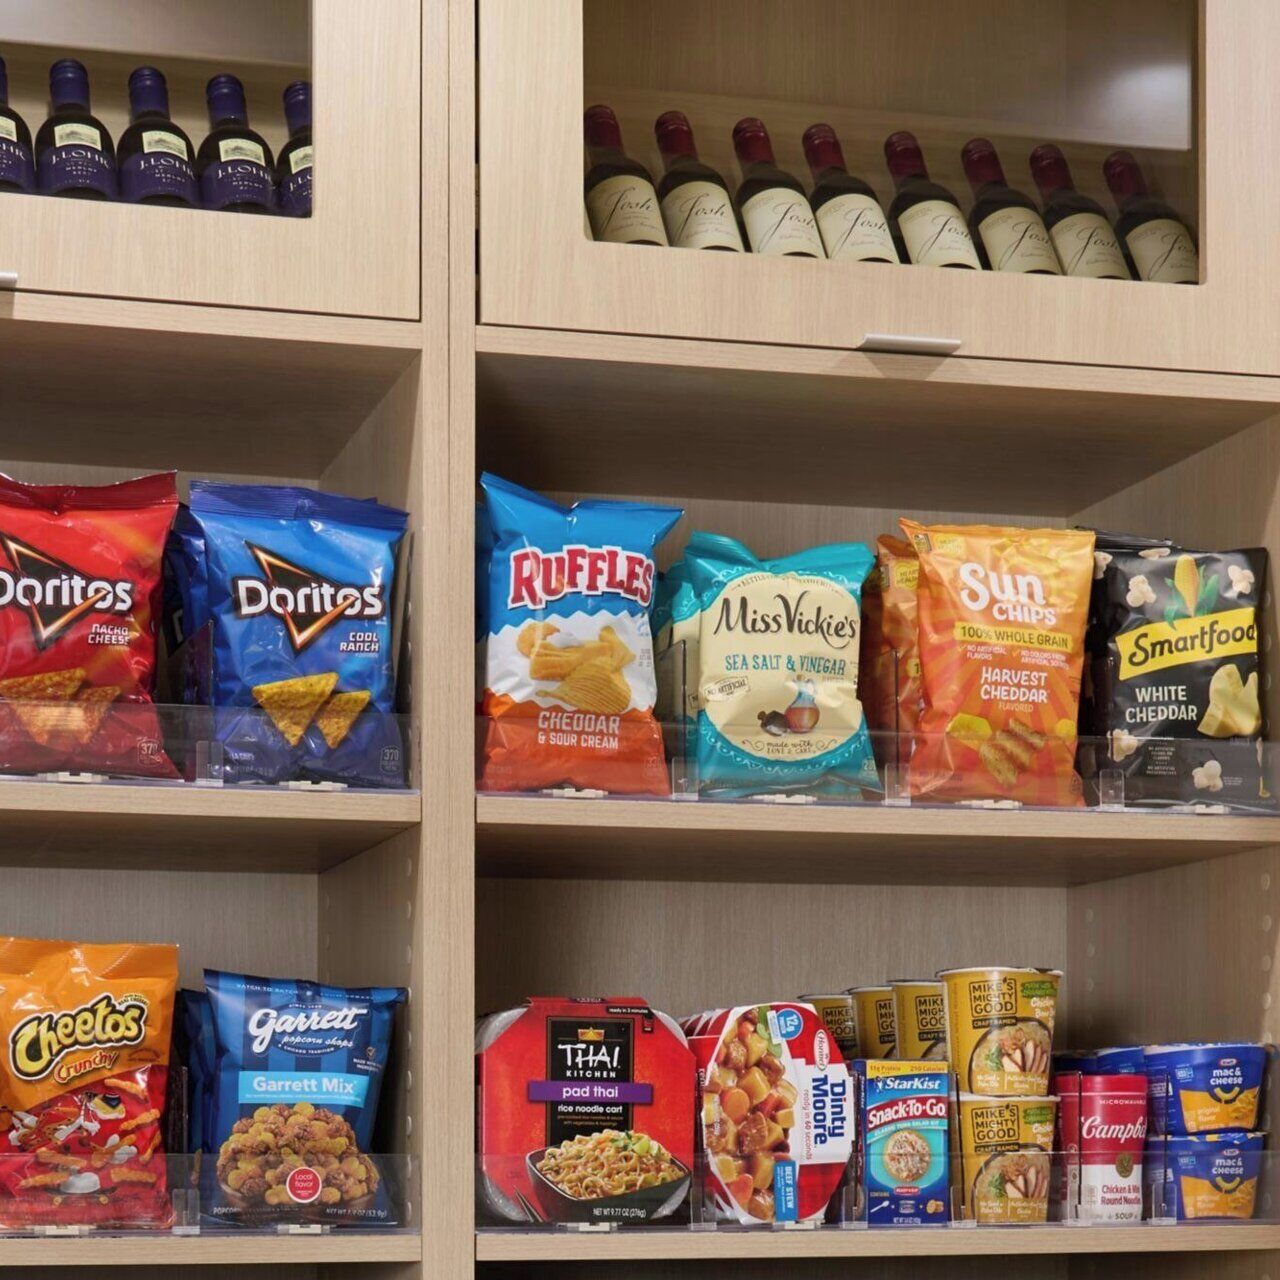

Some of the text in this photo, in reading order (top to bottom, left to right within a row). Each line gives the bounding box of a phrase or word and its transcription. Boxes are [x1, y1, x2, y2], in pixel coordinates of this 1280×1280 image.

[511, 547, 653, 607] RUFFLES
[960, 563, 1045, 610] Sun
[239, 579, 382, 616] Doritos
[714, 596, 780, 635] Miss
[993, 606, 1056, 625] CHIPS
[93, 625, 129, 635] NACHO
[349, 632, 378, 642] COOL
[961, 626, 1068, 648] 100% WHOLE GRAIN
[88, 634, 130, 644] CHEESE
[340, 642, 379, 652] RANCH
[725, 655, 845, 675] SEA SALT & VINEGAR
[981, 666, 1047, 687] HARVEST
[980, 684, 1048, 703] CHEDDAR
[1136, 686, 1187, 702] WHITE
[999, 703, 1033, 713] FLAVORED
[1126, 706, 1197, 723] CHEDDAR
[538, 712, 620, 732] CHEDDAR
[549, 733, 618, 749] SOUR CREAM
[973, 992, 1013, 1003] MIGHTY
[974, 1002, 1013, 1014] GOOD
[13, 996, 144, 1075] Cheetos
[282, 1036, 353, 1048] popcorn shops
[558, 1044, 620, 1069] THAI
[55, 1050, 118, 1084] Crunchy
[253, 1077, 353, 1093] Garrett Mix
[885, 1077, 940, 1090] StarKist
[563, 1086, 618, 1098] pad thai
[576, 1105, 603, 1113] noodle
[812, 1075, 828, 1145] Moore
[829, 1080, 846, 1138] Dinty
[975, 1119, 1016, 1129] MIGHTY
[977, 1129, 1016, 1140] GOOD
[1102, 1185, 1126, 1193] Chicken
[1101, 1196, 1122, 1205] Round
